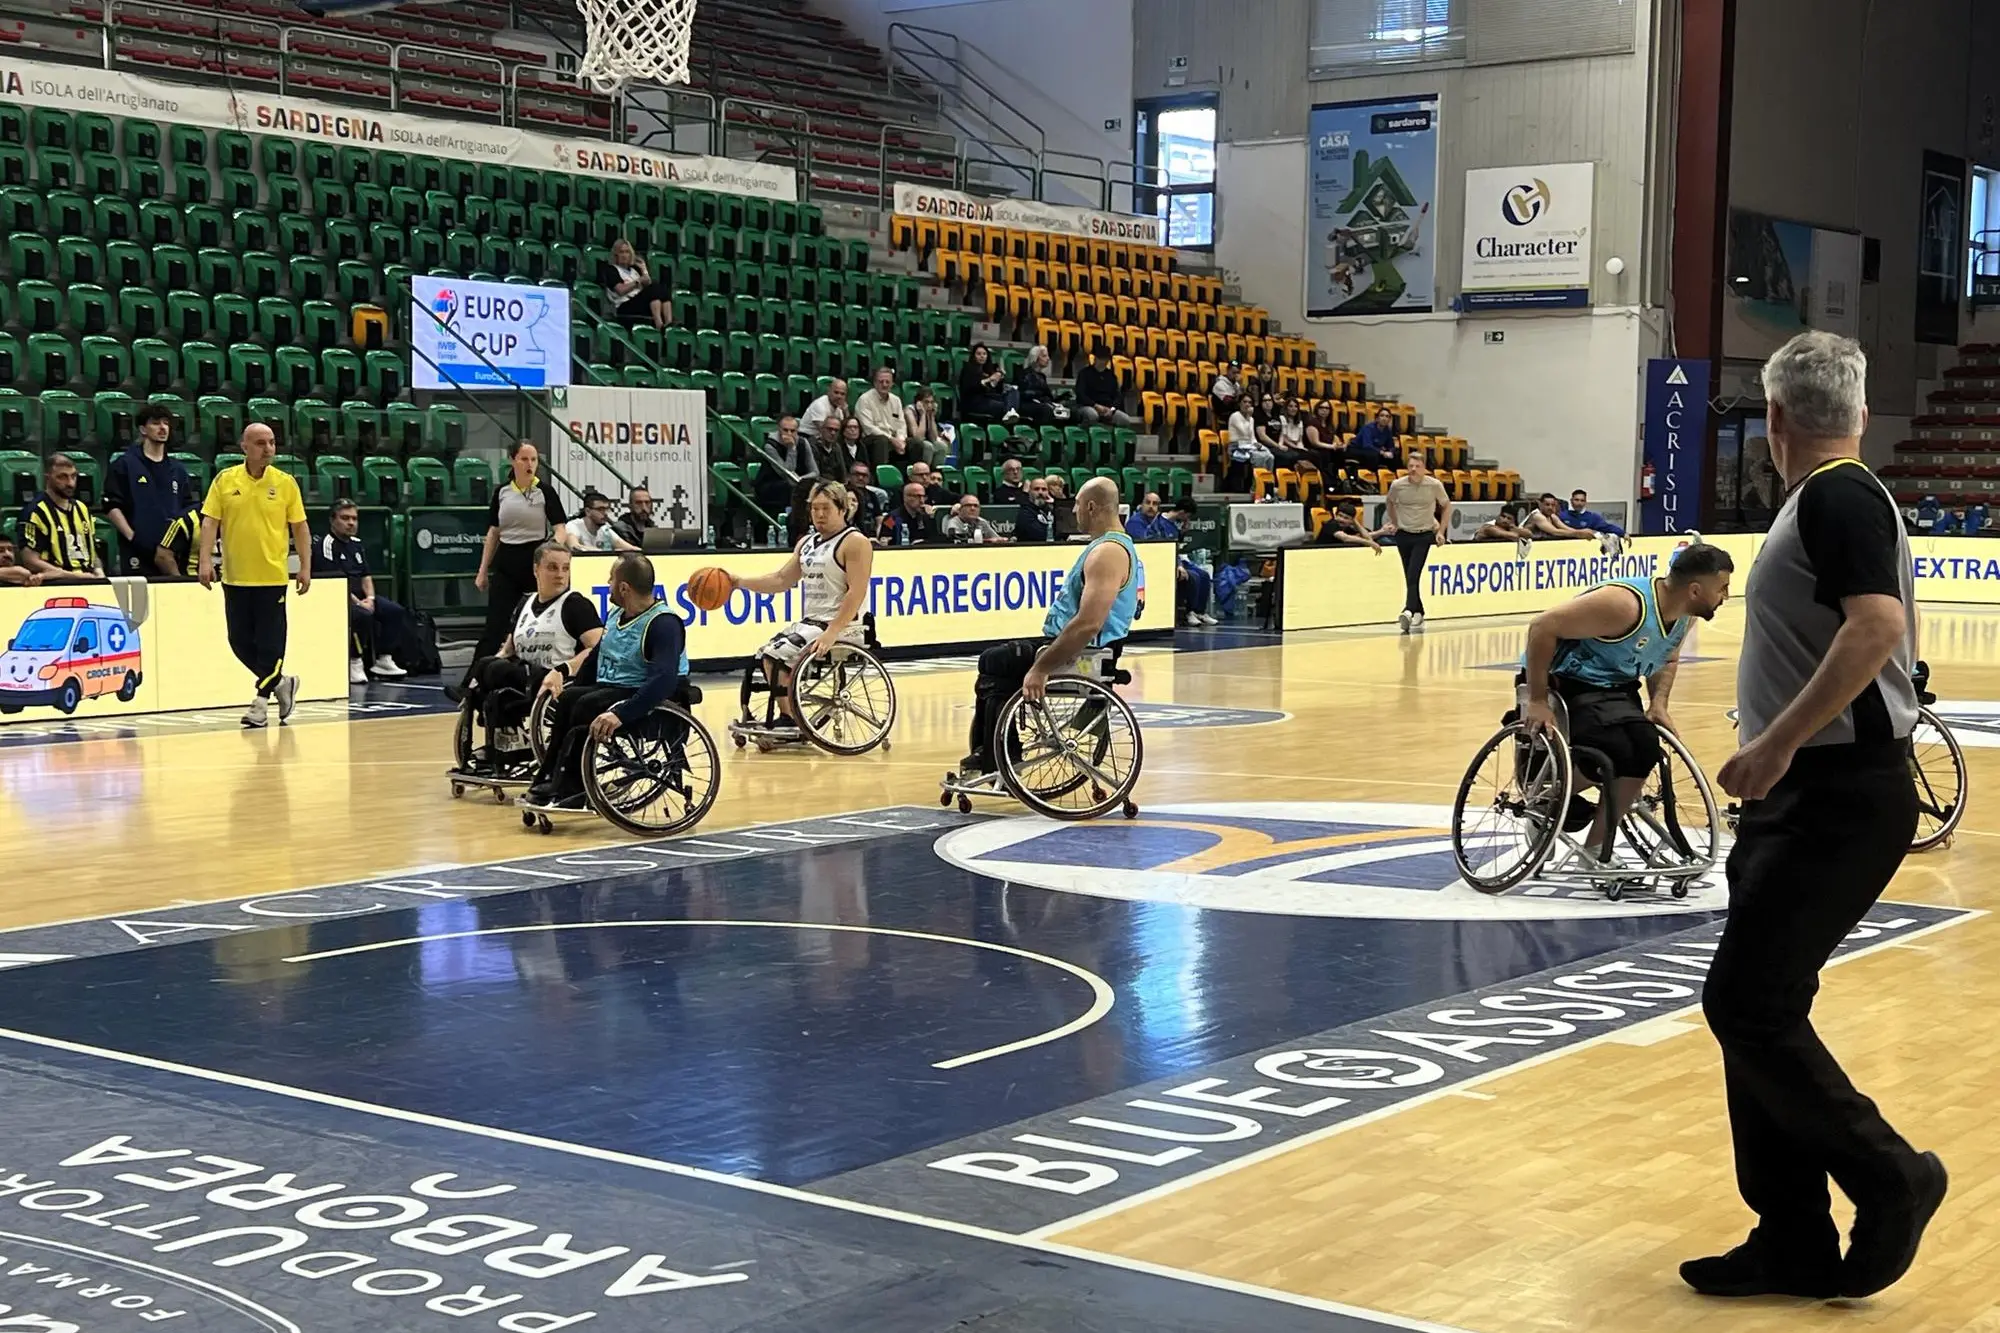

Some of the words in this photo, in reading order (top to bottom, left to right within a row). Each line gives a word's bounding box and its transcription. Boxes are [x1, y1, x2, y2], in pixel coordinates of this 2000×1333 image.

[31, 80, 74, 98] ISOLA
[78, 86, 179, 113] dell'Artigianato
[256, 105, 384, 143] SARDEGNA
[390, 129, 424, 144] ISOLA
[426, 134, 508, 155] dell'Artigianato
[1319, 135, 1349, 148] CASA
[576, 149, 680, 181] SARDEGNA
[916, 195, 994, 223] SARDEGNA
[1091, 218, 1157, 241] SARDEGNA
[1476, 236, 1578, 259] Character
[463, 295, 524, 321] EURO
[471, 331, 518, 357] CUP
[569, 420, 692, 446] SARDEGNA
[1428, 560, 1530, 596] TRASPORTI
[1535, 554, 1658, 590] EXTRAREGIONE
[1914, 557, 2000, 580] EXTRA
[868, 569, 1065, 617] TRAREGIONE
[86, 668, 111, 680] CROCE
[110, 816, 940, 945] ACRISURE
[926, 1076, 1350, 1196] BLUE
[1369, 917, 1918, 1063] ASSISTA
[58, 1134, 750, 1297] ARBOREA
[0, 1167, 598, 1333] PRODUTTOR
[0, 1255, 188, 1322] FORMA
